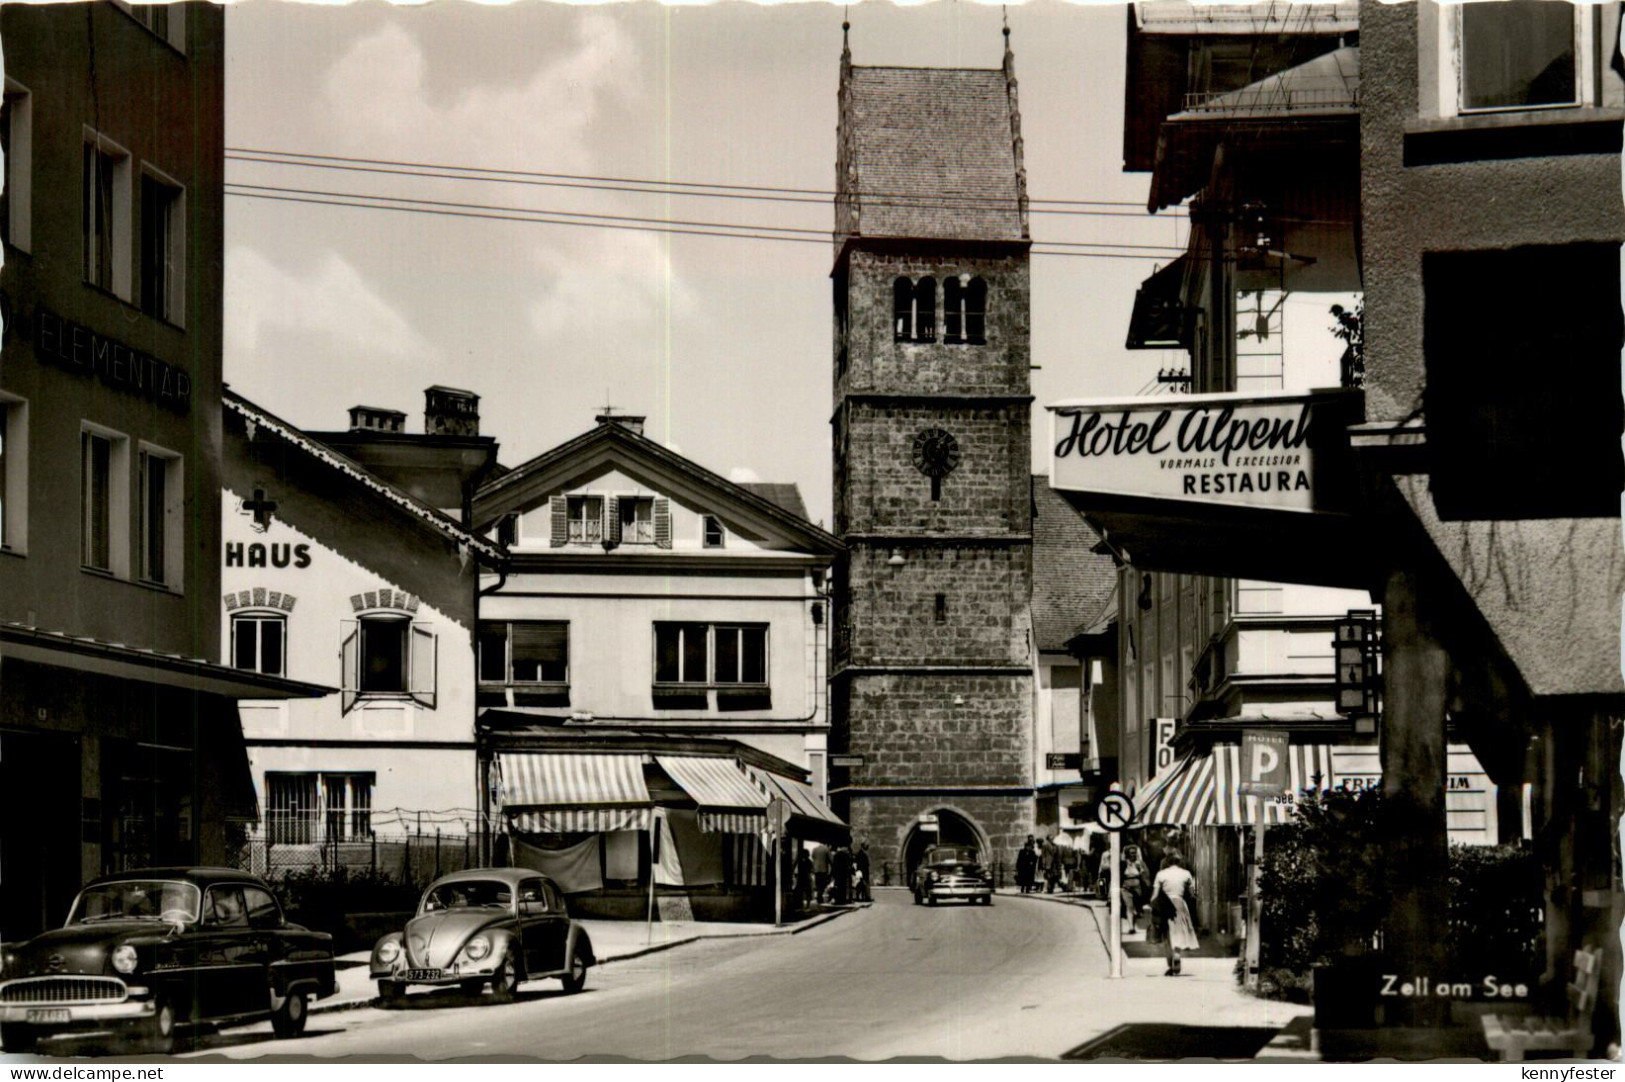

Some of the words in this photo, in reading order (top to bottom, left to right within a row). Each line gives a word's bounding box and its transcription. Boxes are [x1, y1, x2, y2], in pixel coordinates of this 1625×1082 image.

[41, 313, 191, 401] ELEMENTAR
[1055, 410, 1172, 458] Hotel
[1160, 459, 1216, 469] VORMALS
[1235, 455, 1300, 467] EXCELSIOR
[1183, 470, 1310, 495] RESTAURA
[226, 542, 311, 568] HAUS
[1251, 743, 1279, 782] P
